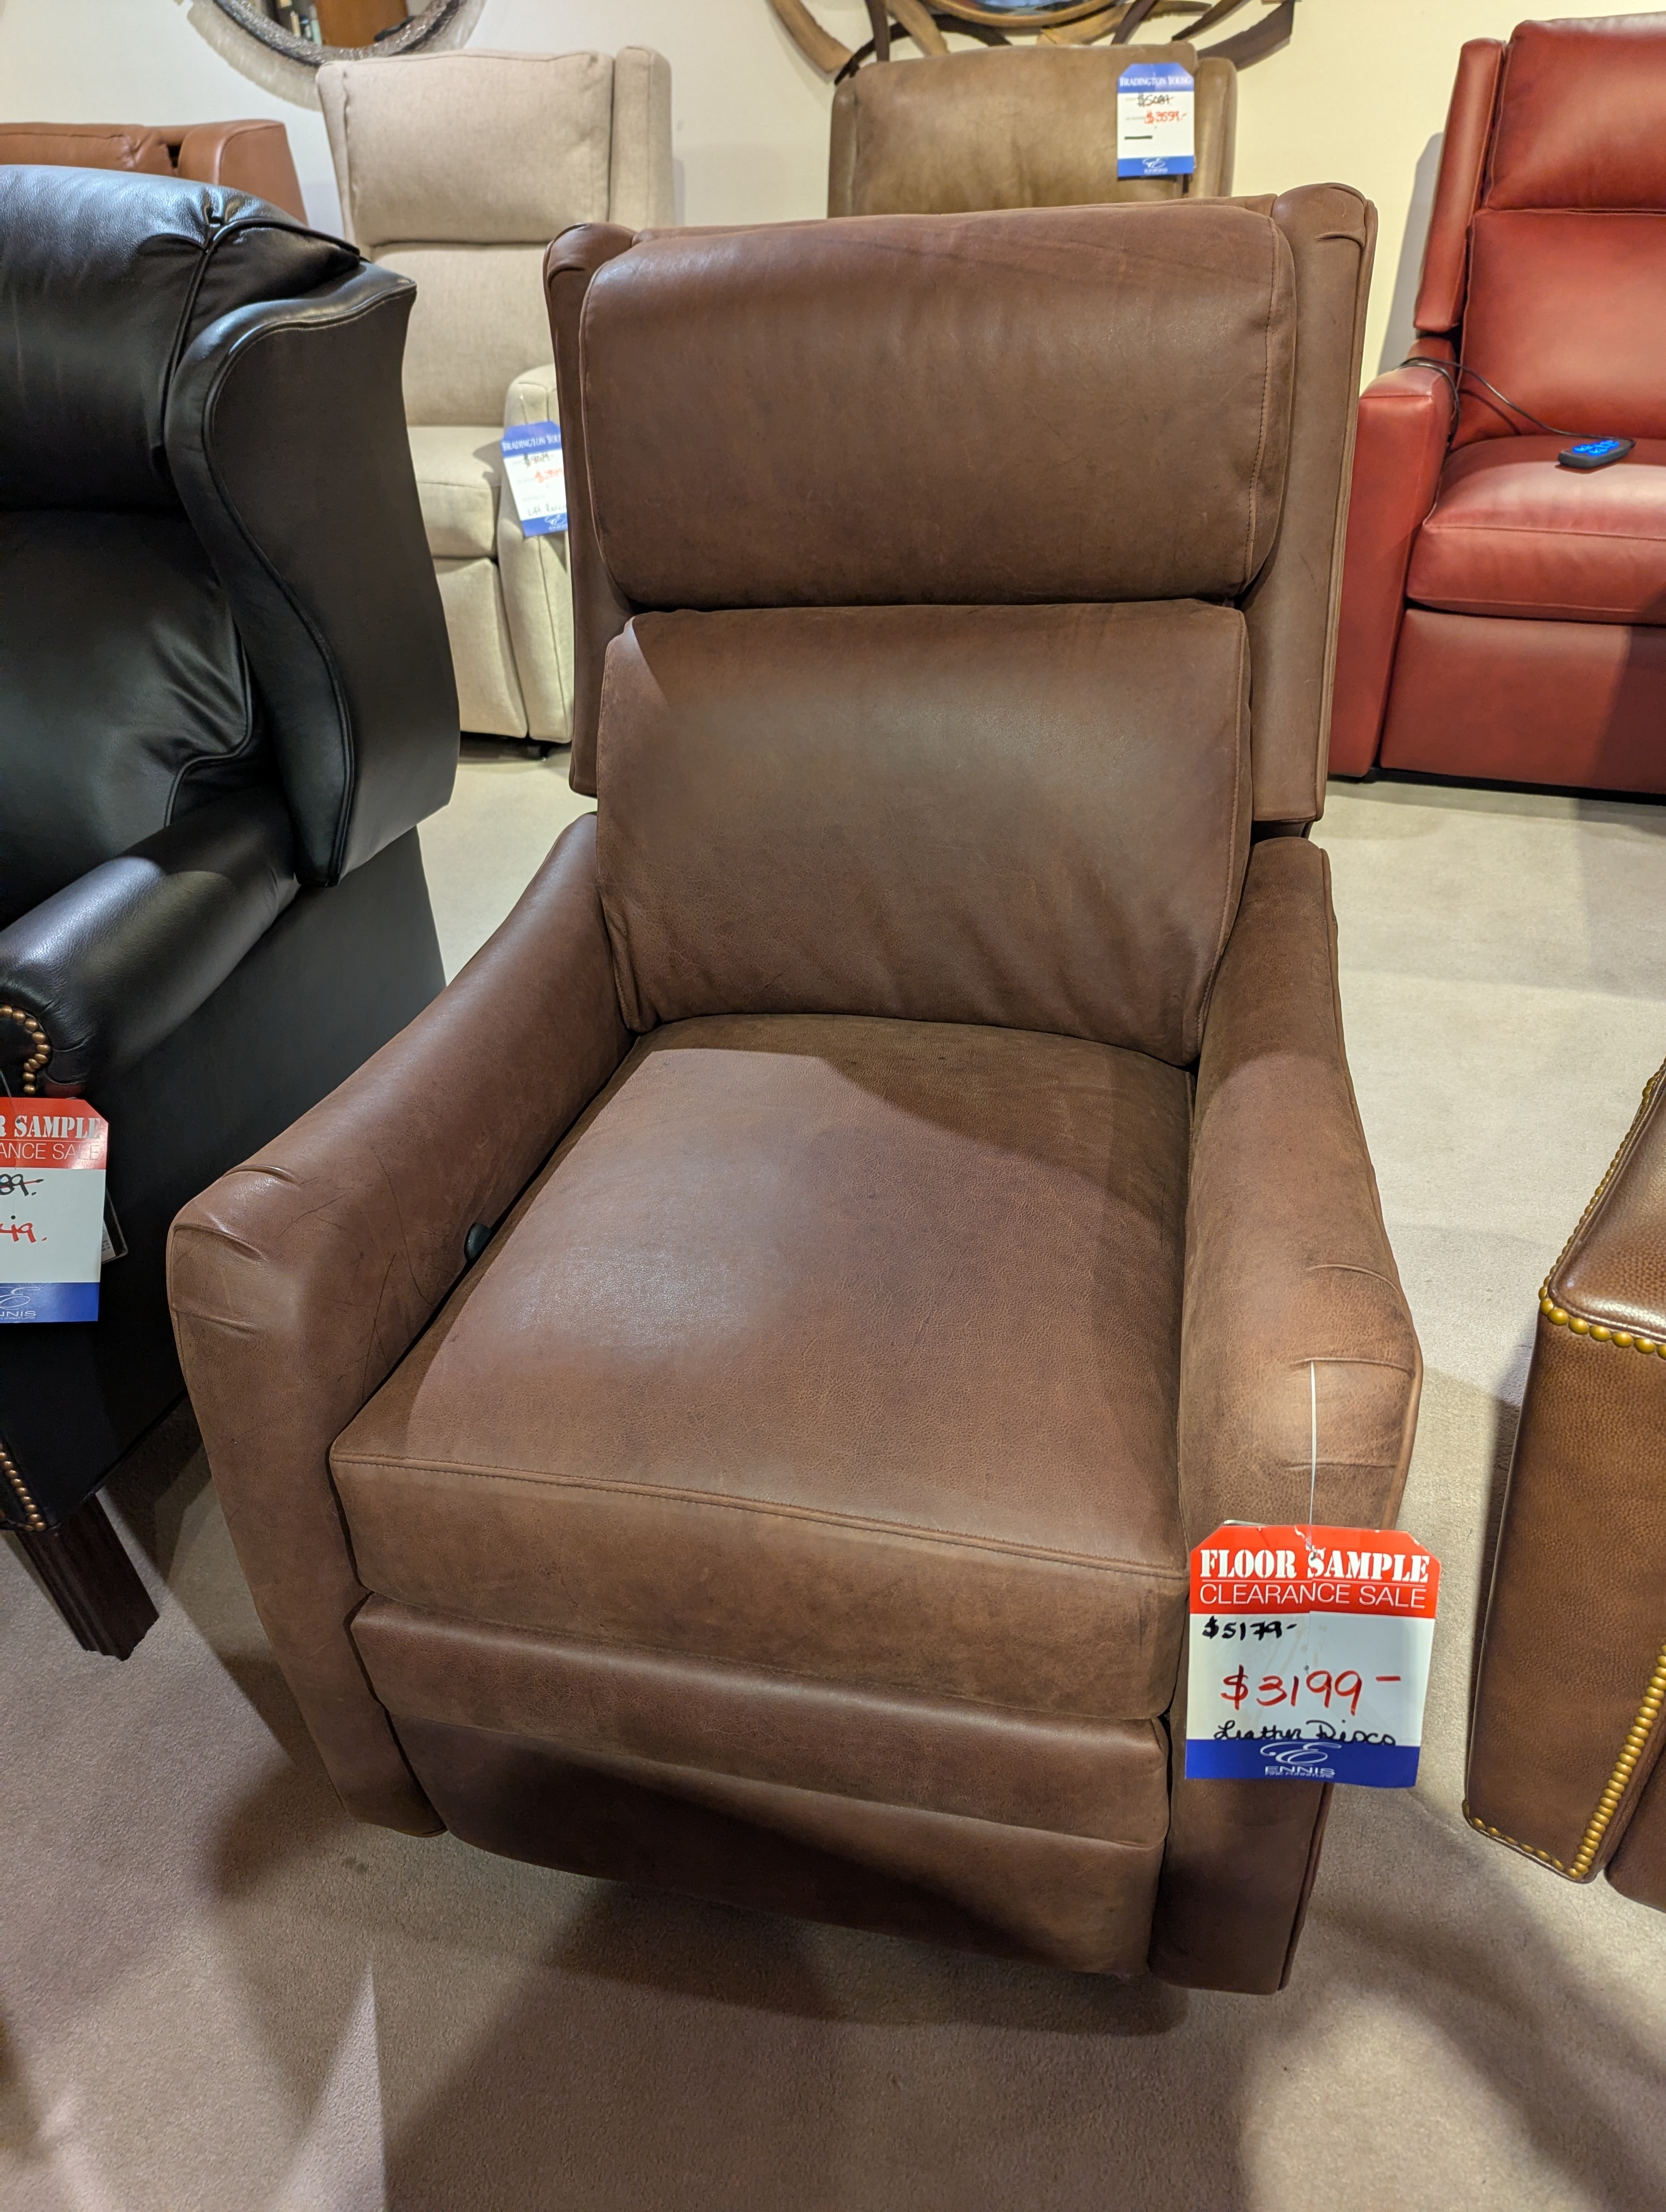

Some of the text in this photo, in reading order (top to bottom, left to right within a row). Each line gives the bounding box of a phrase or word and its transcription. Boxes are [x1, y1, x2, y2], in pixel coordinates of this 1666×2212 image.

[14, 1115, 101, 1139] SAMPLE
[52, 1143, 100, 1160] SALE
[1200, 1547, 1430, 1583] FLOOR SAMPLE
[1200, 1583, 1426, 1609] CLEARANCE SALE
[1265, 1765, 1335, 1776] ENNIS
